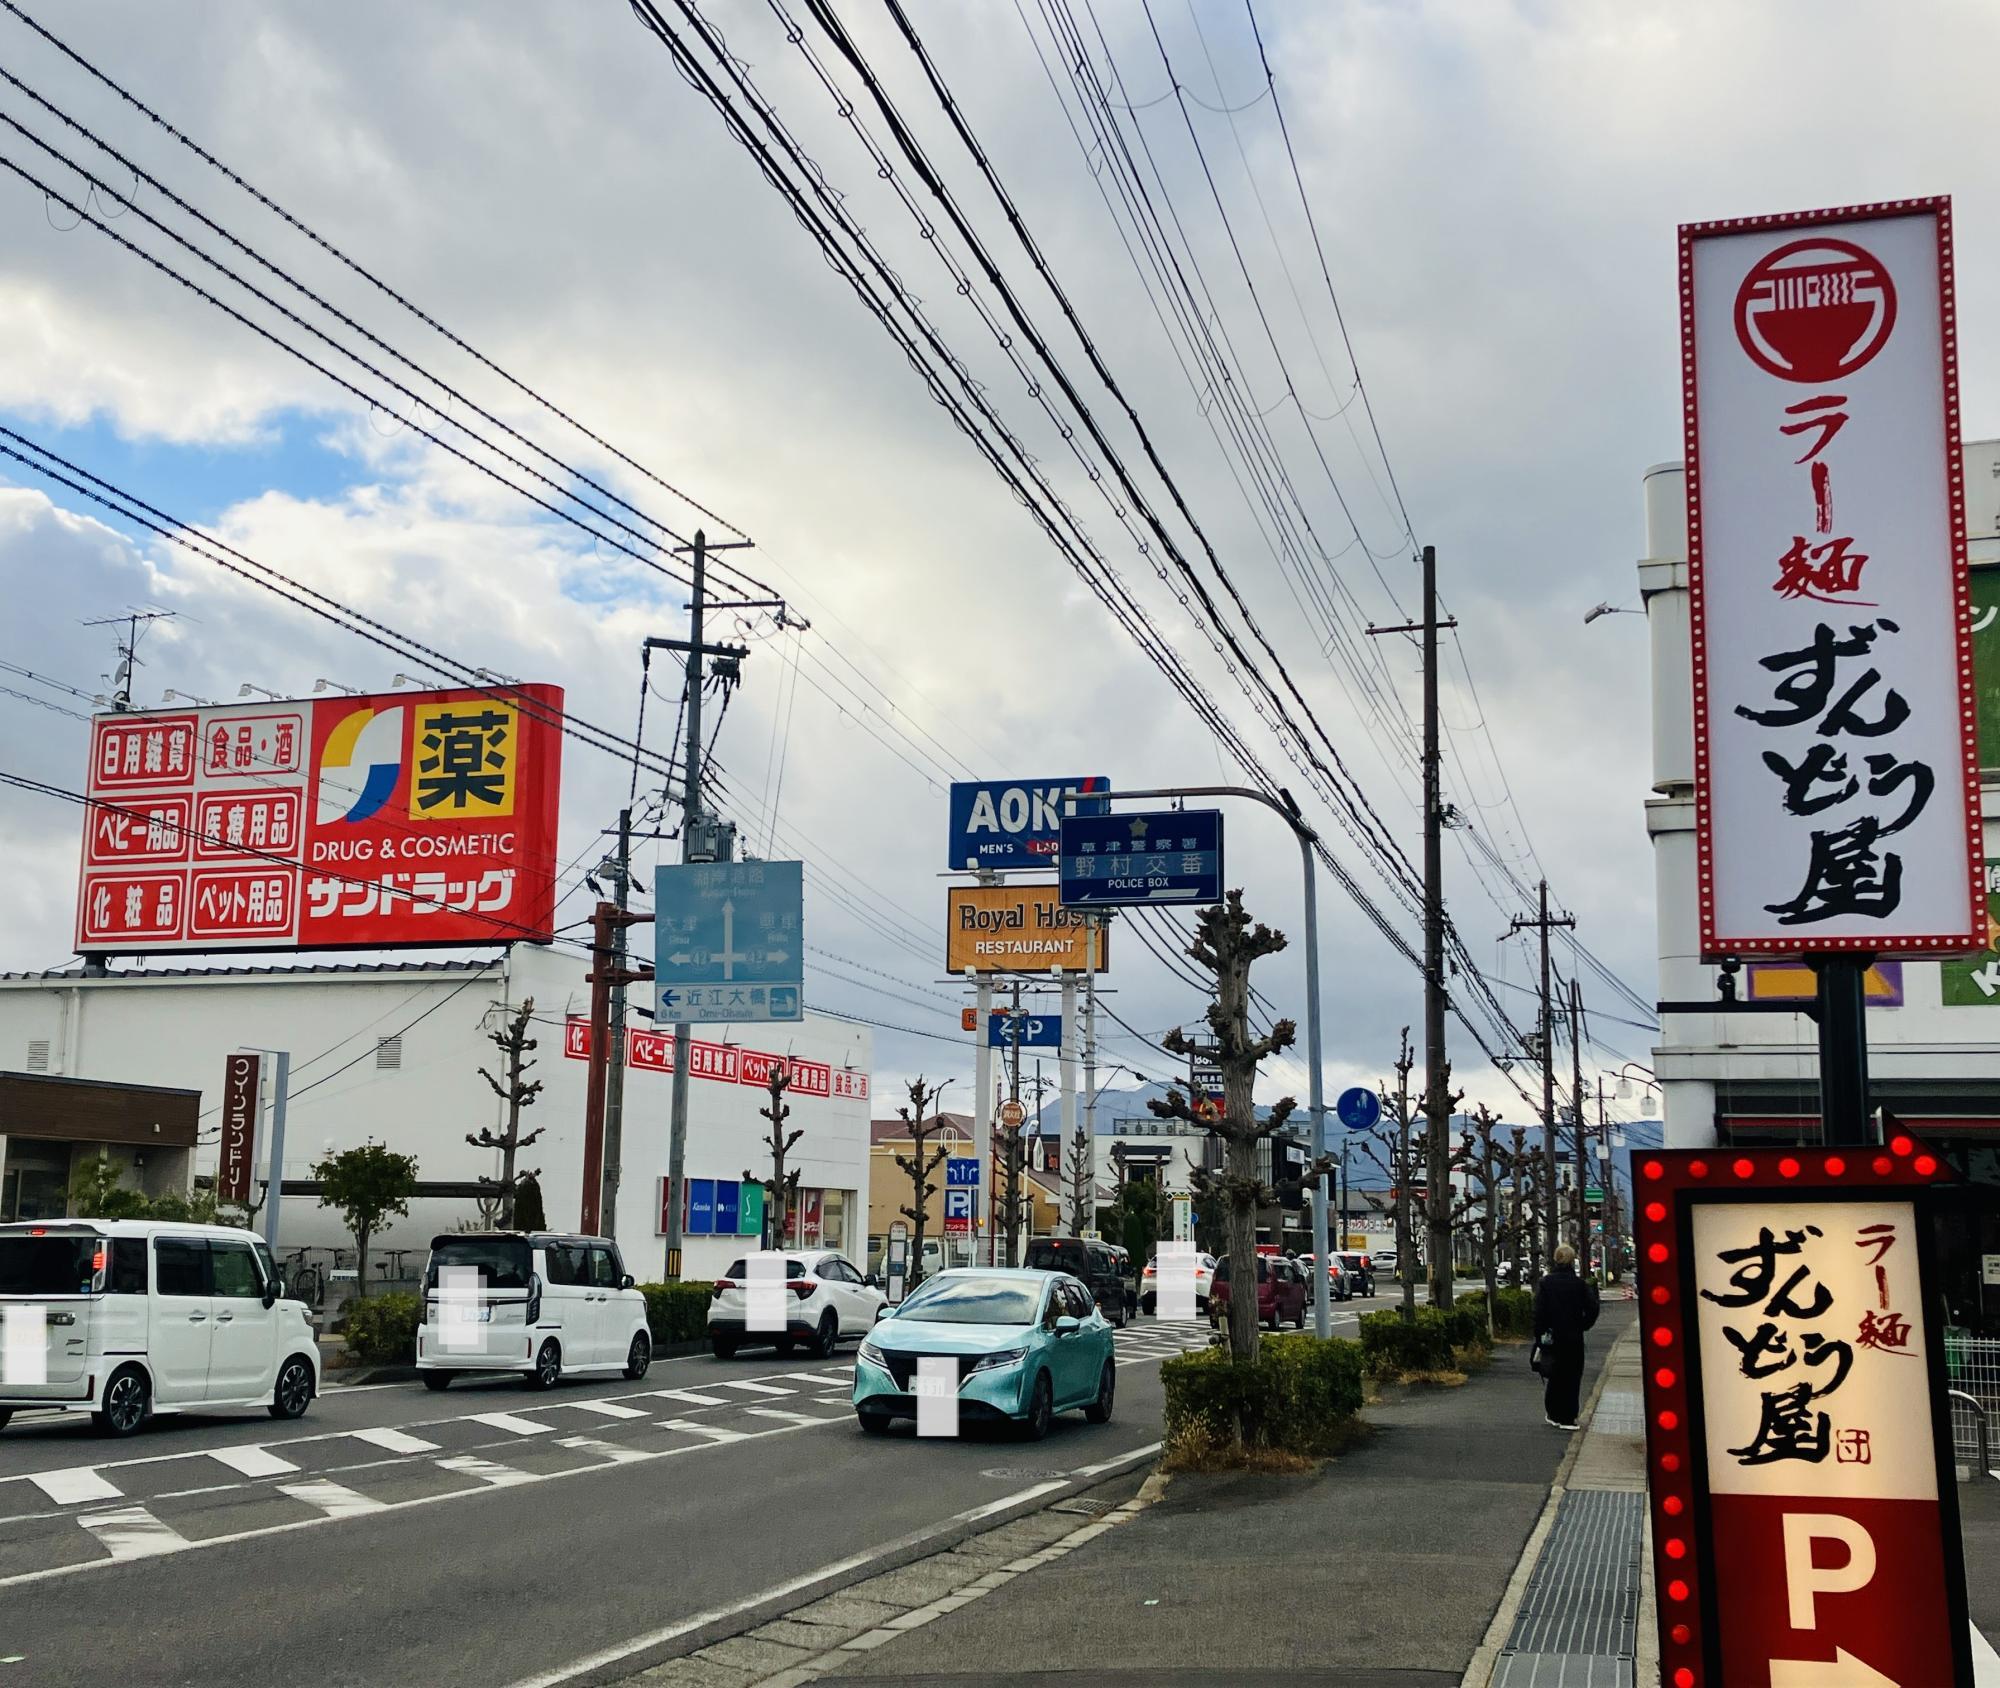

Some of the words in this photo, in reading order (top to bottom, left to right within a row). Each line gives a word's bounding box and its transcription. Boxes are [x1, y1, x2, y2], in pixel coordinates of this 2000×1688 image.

[1773, 396, 1878, 606] ラー麺
[103, 729, 187, 775] 日用雑貨
[417, 710, 509, 810] 薬
[204, 802, 288, 847] 医療用品
[312, 839, 374, 862] DRUG
[379, 838, 396, 859] &
[400, 833, 515, 858] COSMETIC
[1075, 854, 1203, 878] 野村交番
[200, 880, 283, 922] ペット用品
[307, 869, 516, 918] サンドラッグ
[1108, 879, 1144, 889] POLICE
[1148, 877, 1169, 888] BOX
[94, 885, 173, 928] 化粧品
[959, 903, 1024, 935] Royal
[1033, 902, 1089, 929] Hos
[975, 939, 1074, 954] RESTAURANT
[687, 989, 765, 1006] 近江大橋
[1027, 1020, 1044, 1041] P
[692, 1048, 734, 1077] 日用雑貨
[229, 1058, 249, 1200] コインランドリー
[948, 1191, 969, 1217] P
[1855, 1224, 1918, 1357] ラー麺
[1782, 1512, 1877, 1631] P
